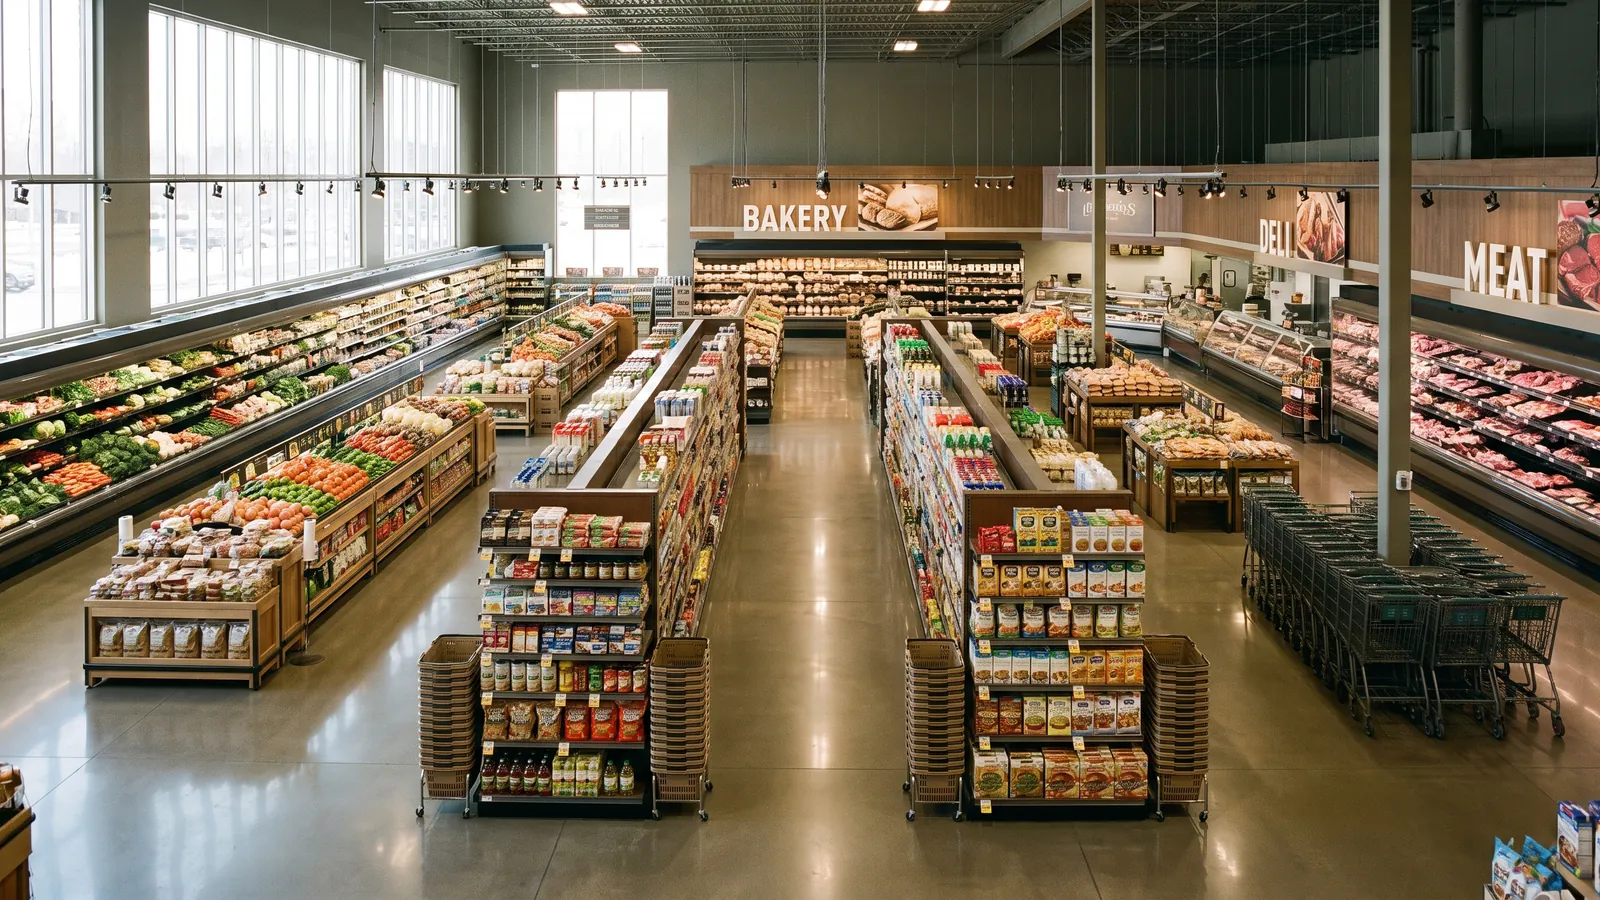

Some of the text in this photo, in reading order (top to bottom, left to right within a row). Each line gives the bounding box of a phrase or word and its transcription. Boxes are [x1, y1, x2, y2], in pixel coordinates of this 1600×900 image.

[743, 204, 847, 232] BAKERY
[1259, 218, 1290, 258] DELI
[1464, 240, 1548, 305] MEAT
